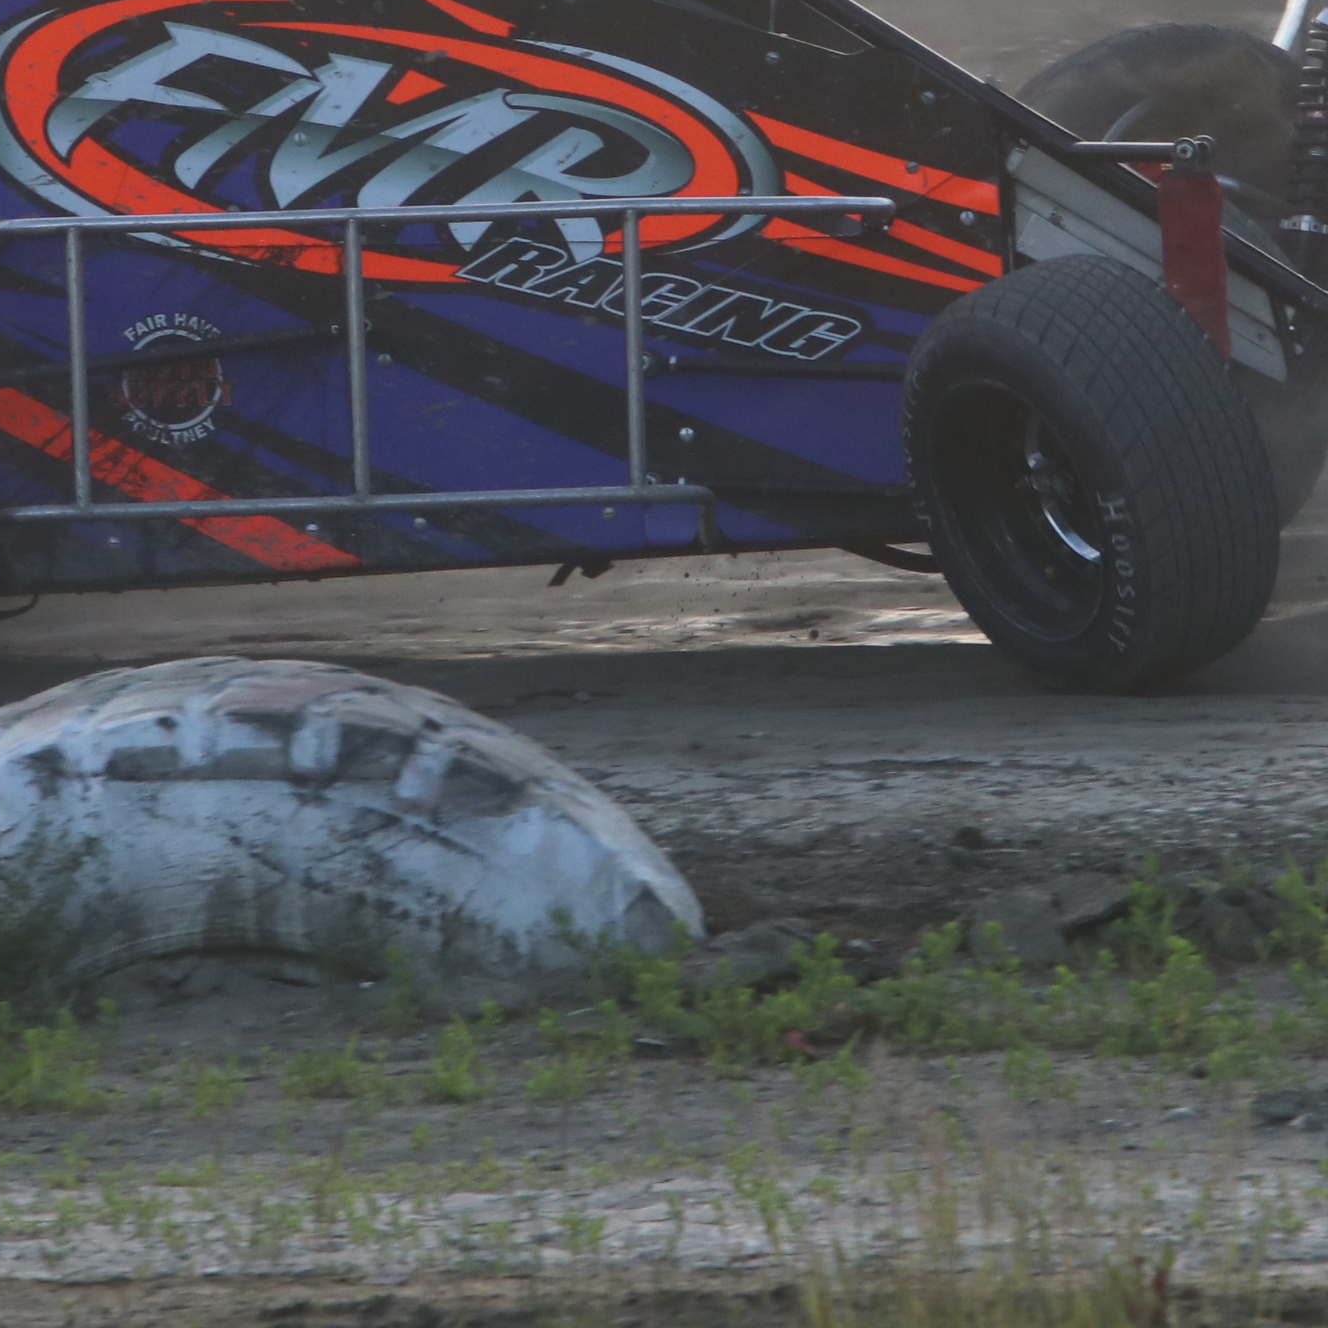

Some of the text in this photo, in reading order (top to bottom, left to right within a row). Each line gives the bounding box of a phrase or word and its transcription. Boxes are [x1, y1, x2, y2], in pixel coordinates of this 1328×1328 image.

[123, 312, 222, 342] FAIR HAVE
[455, 237, 862, 361] RACING
